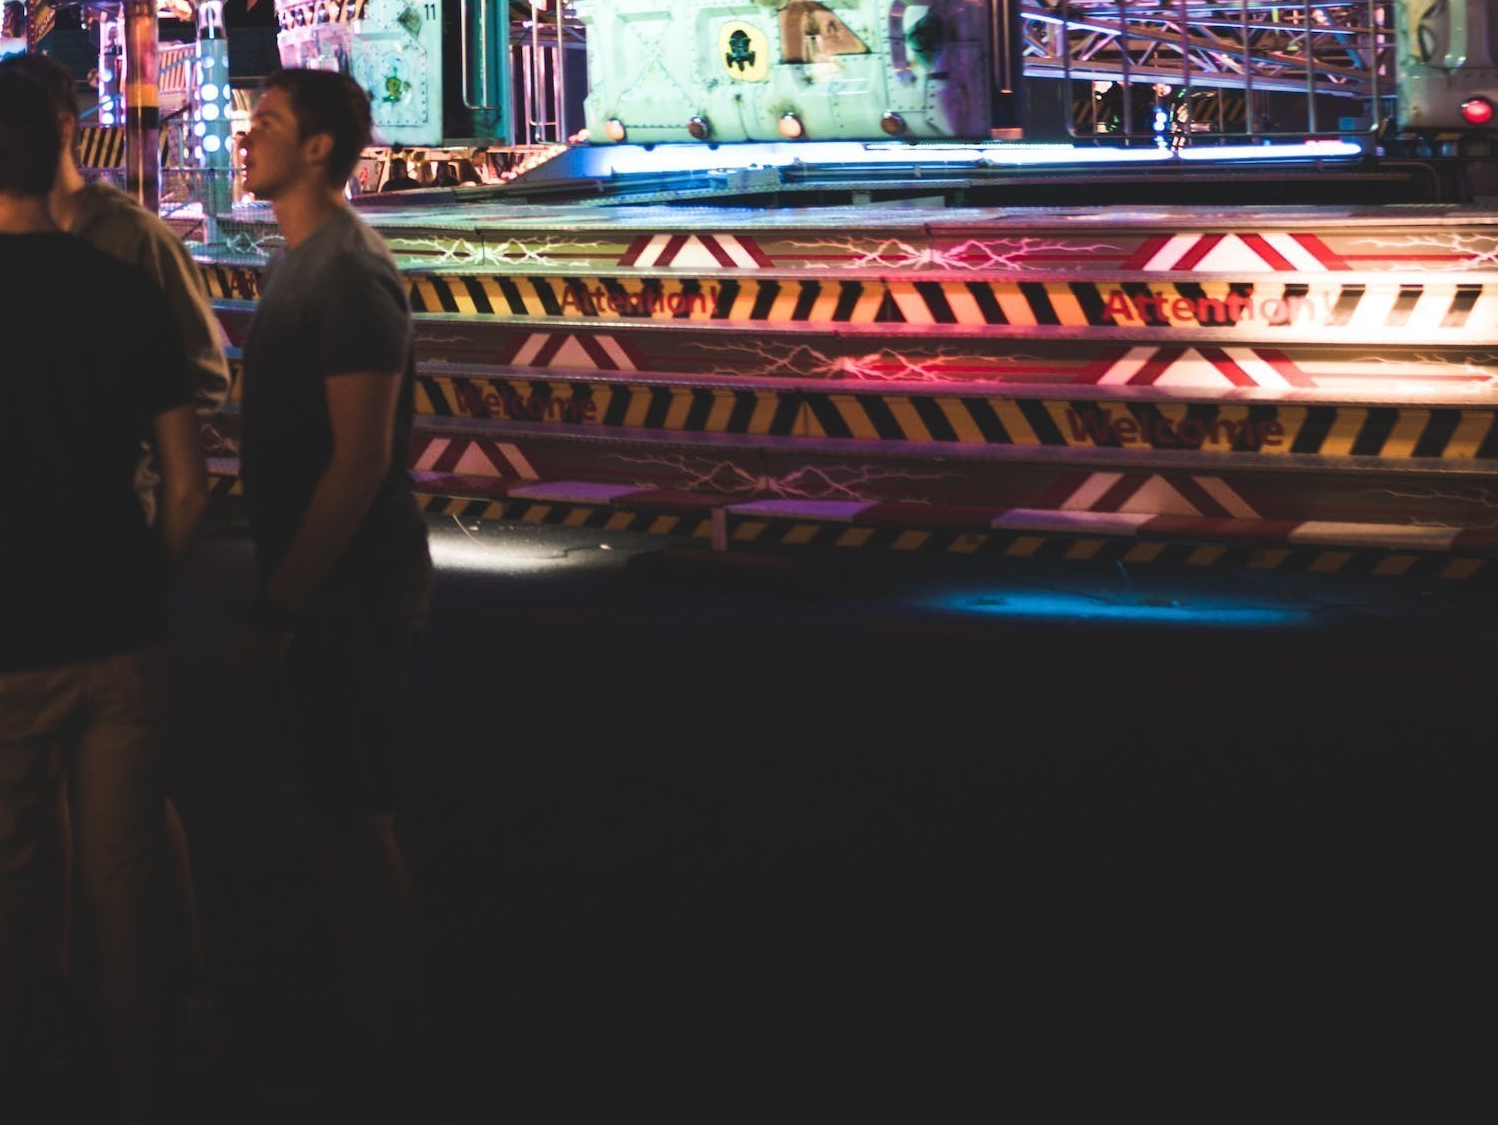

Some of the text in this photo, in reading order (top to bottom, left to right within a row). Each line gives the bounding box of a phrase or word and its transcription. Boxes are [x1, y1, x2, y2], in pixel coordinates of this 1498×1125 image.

[423, 2, 437, 21] 11
[562, 284, 720, 315] Attention!
[1102, 288, 1331, 325] Attention!
[453, 382, 598, 422] Welcome
[1067, 408, 1285, 447] Welcome
